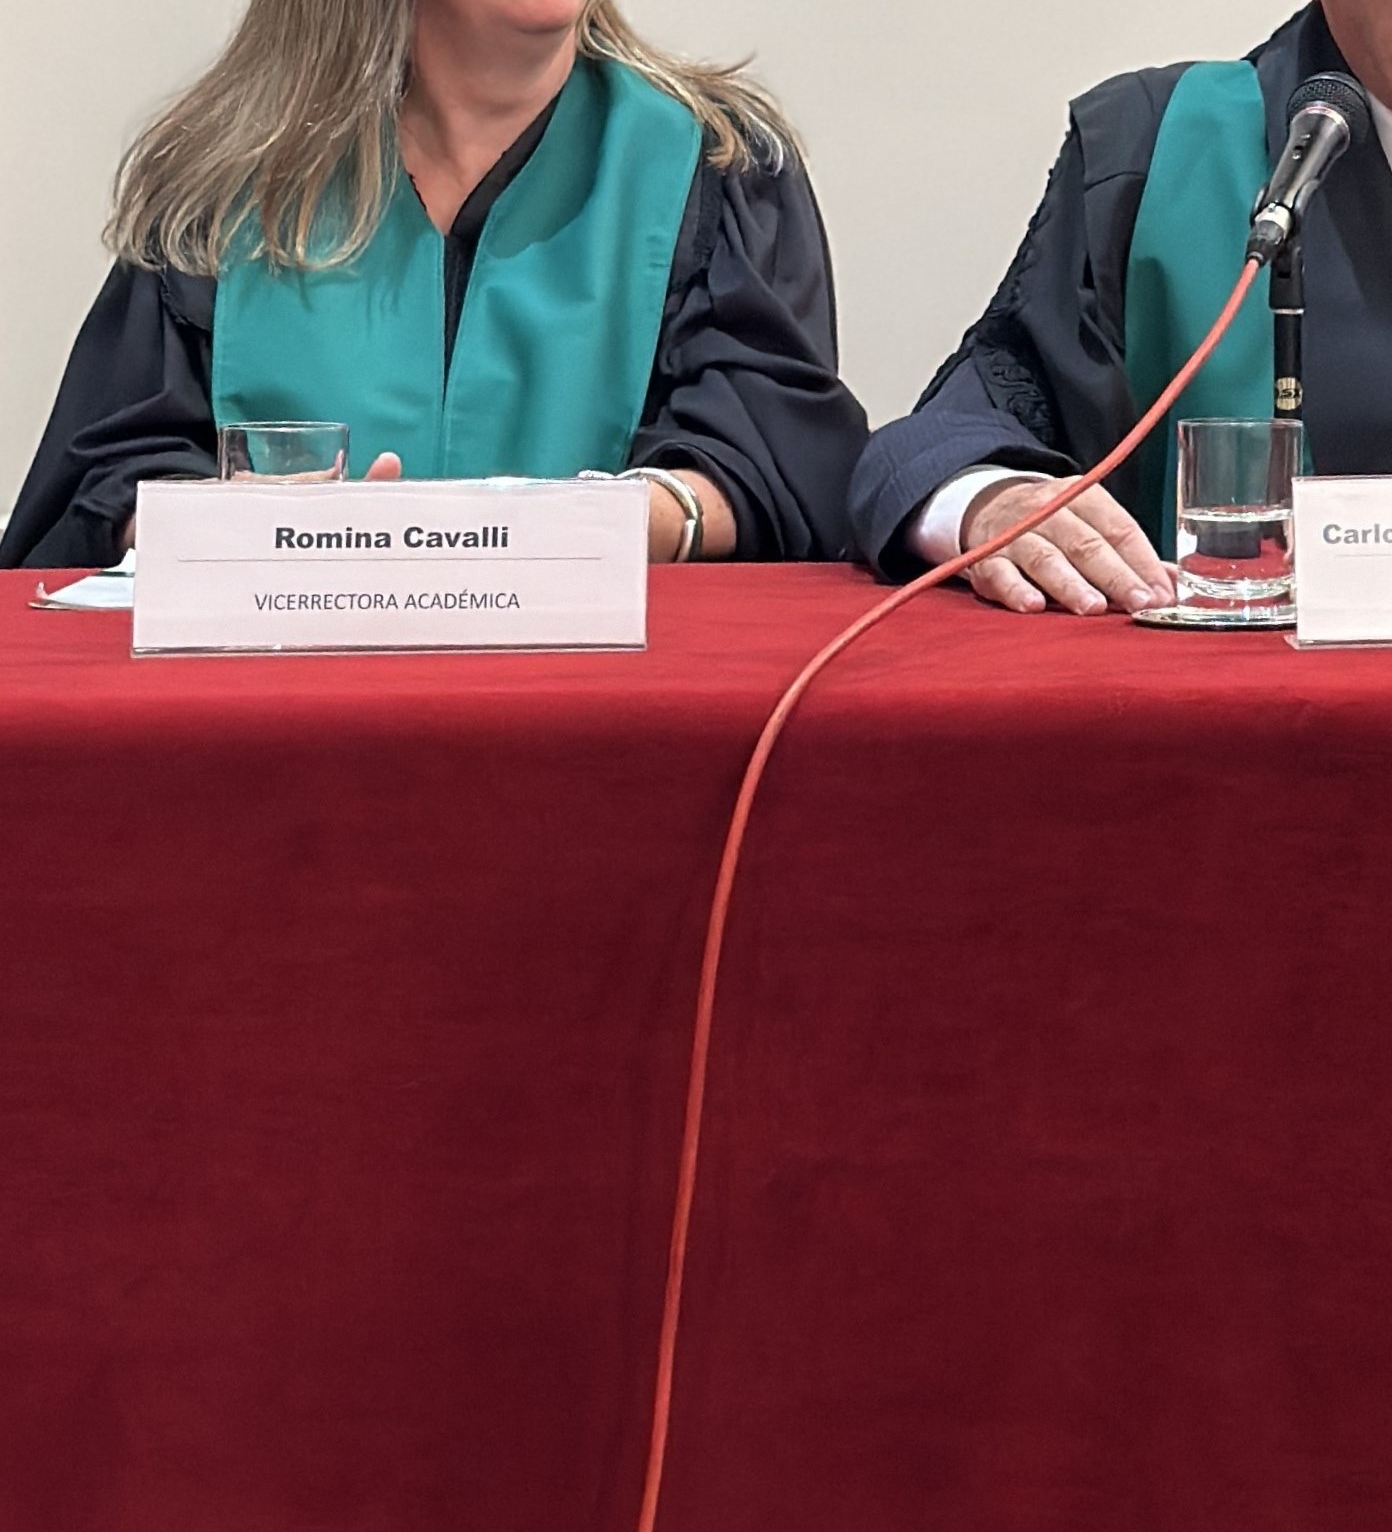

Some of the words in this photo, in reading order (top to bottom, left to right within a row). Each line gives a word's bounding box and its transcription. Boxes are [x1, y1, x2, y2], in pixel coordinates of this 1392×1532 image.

[274, 525, 391, 550] Romina
[403, 525, 509, 549] Cavalli
[254, 592, 398, 612] VICERRECTORA
[403, 588, 521, 611] ACADÉMICA
